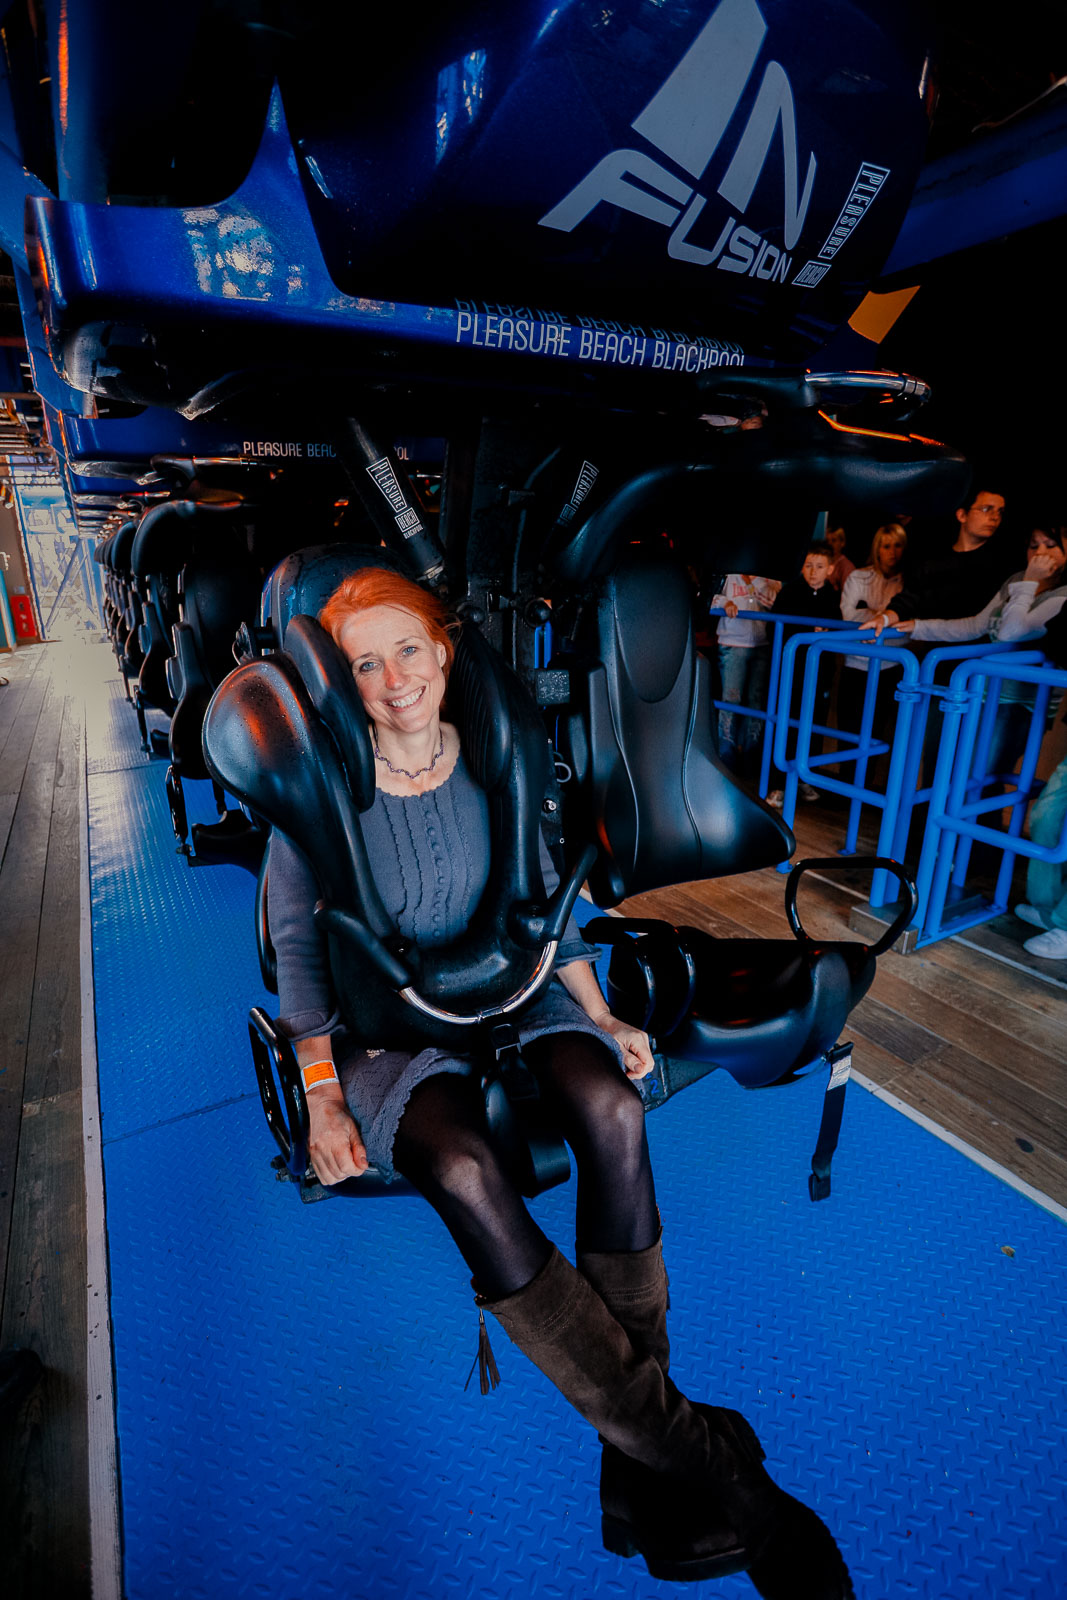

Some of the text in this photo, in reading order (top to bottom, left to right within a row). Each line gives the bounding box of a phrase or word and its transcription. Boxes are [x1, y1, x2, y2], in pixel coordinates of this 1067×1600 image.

[537, 149, 793, 285] FUSION
[822, 169, 885, 255] PLEASURE
[456, 311, 572, 356] PLEASURE
[578, 329, 647, 367] BEACH
[243, 441, 337, 458] PLEASURE BEAC
[370, 461, 405, 509] PLEASURE
[573, 464, 598, 506] PLEASURE
